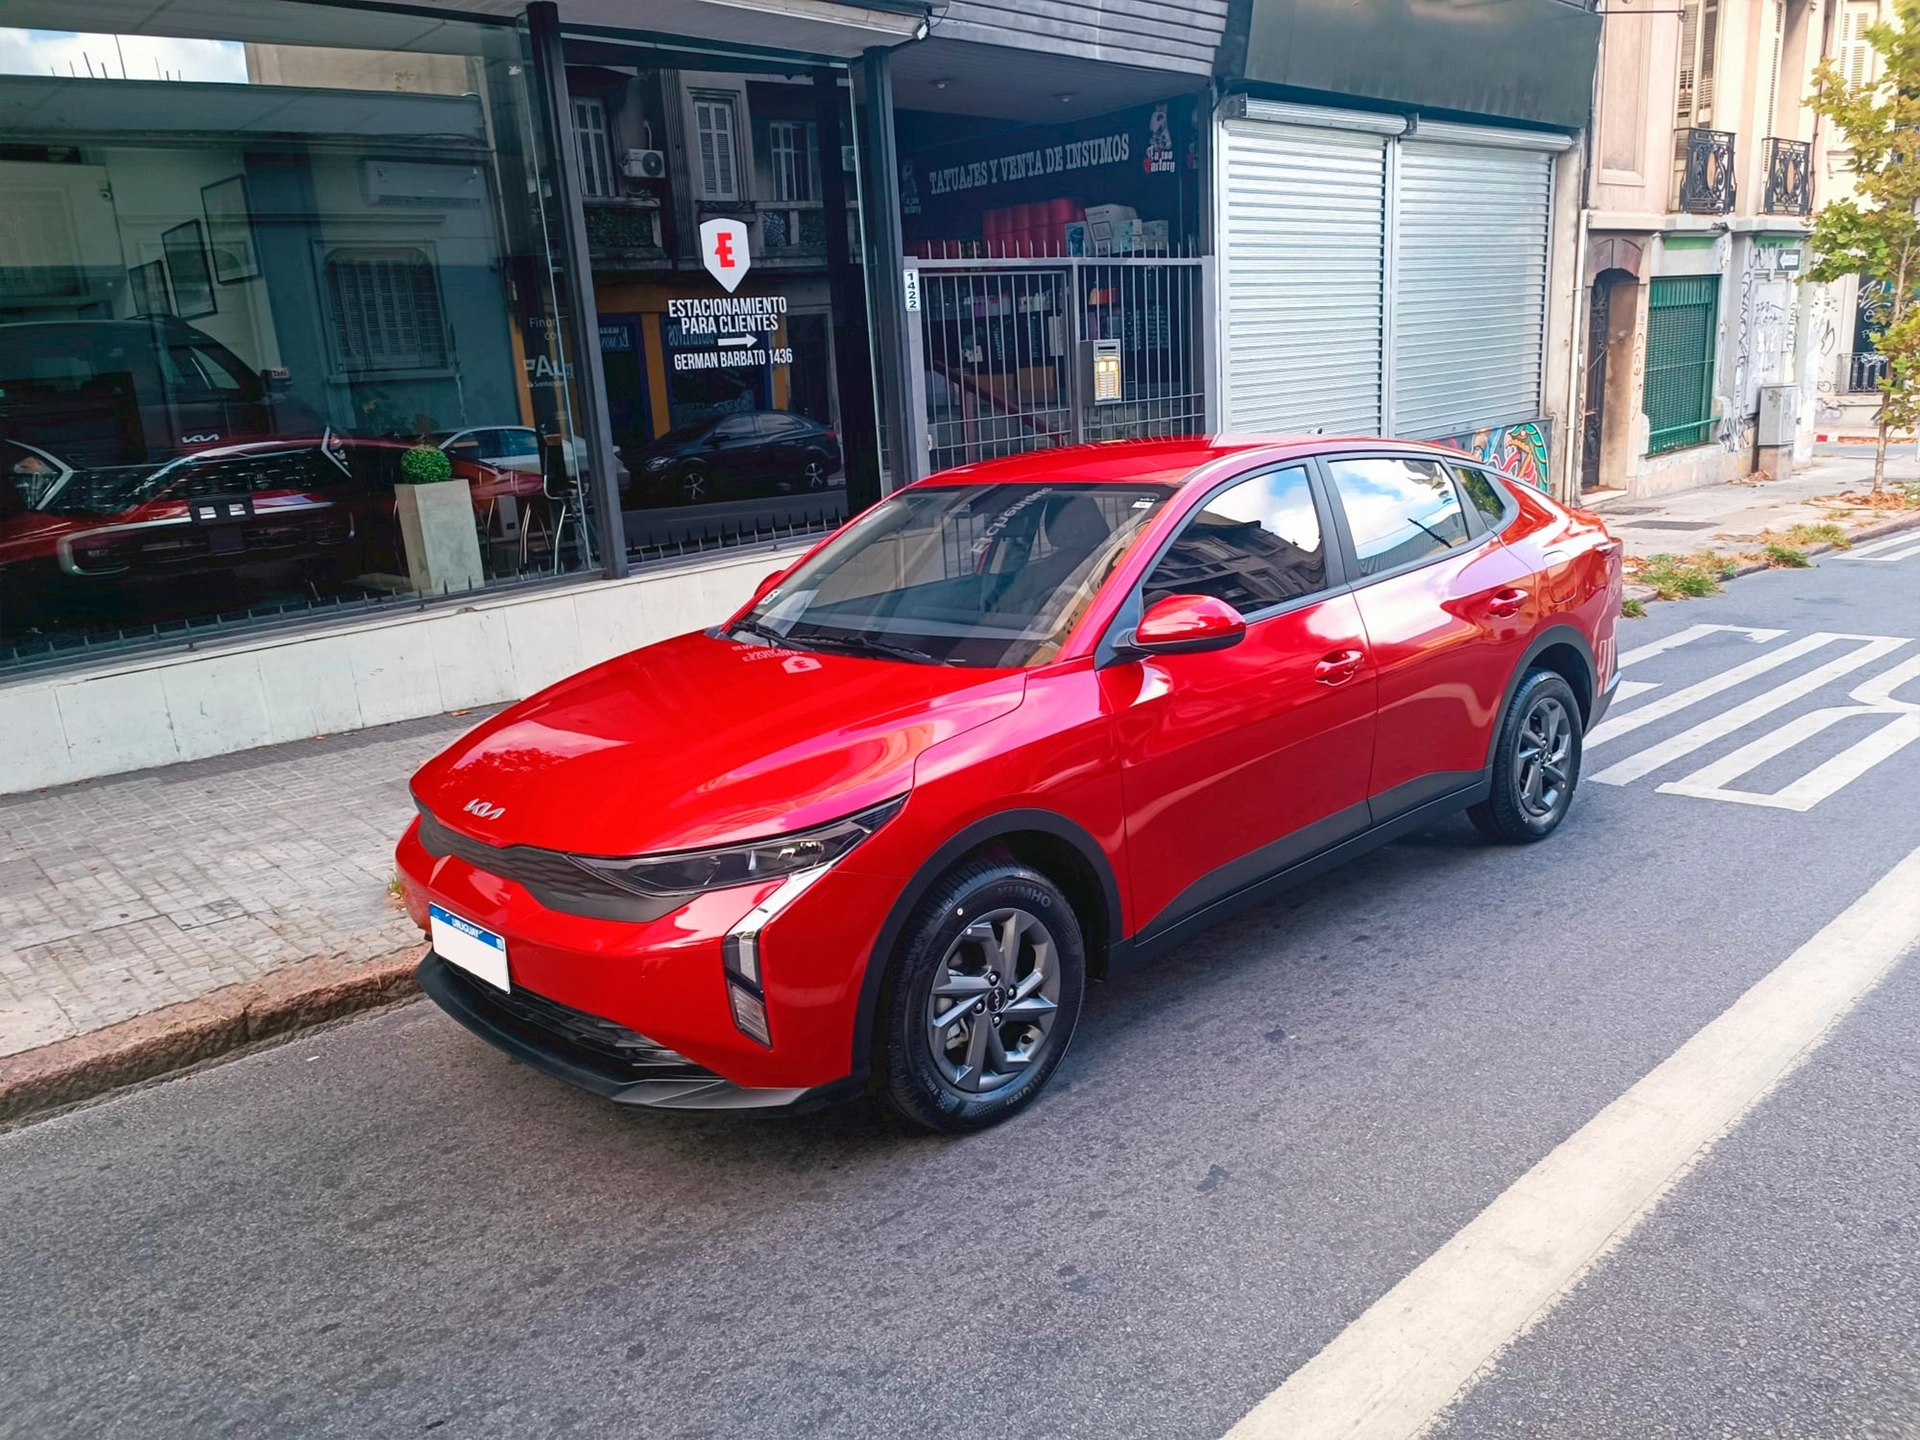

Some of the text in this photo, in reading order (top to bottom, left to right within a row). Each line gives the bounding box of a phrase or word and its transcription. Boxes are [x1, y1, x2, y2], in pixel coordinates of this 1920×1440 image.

[929, 133, 1130, 195] TATUAJES Y VENTA DE INSUMOS
[714, 232, 736, 268] E
[907, 272, 918, 309] 1422
[667, 296, 788, 318] ESTACIONAMIENTO
[680, 313, 779, 335] PARA CLIENTES
[674, 348, 793, 371] GERMAN BARBATO 1436
[451, 917, 480, 939] URUGUAY
